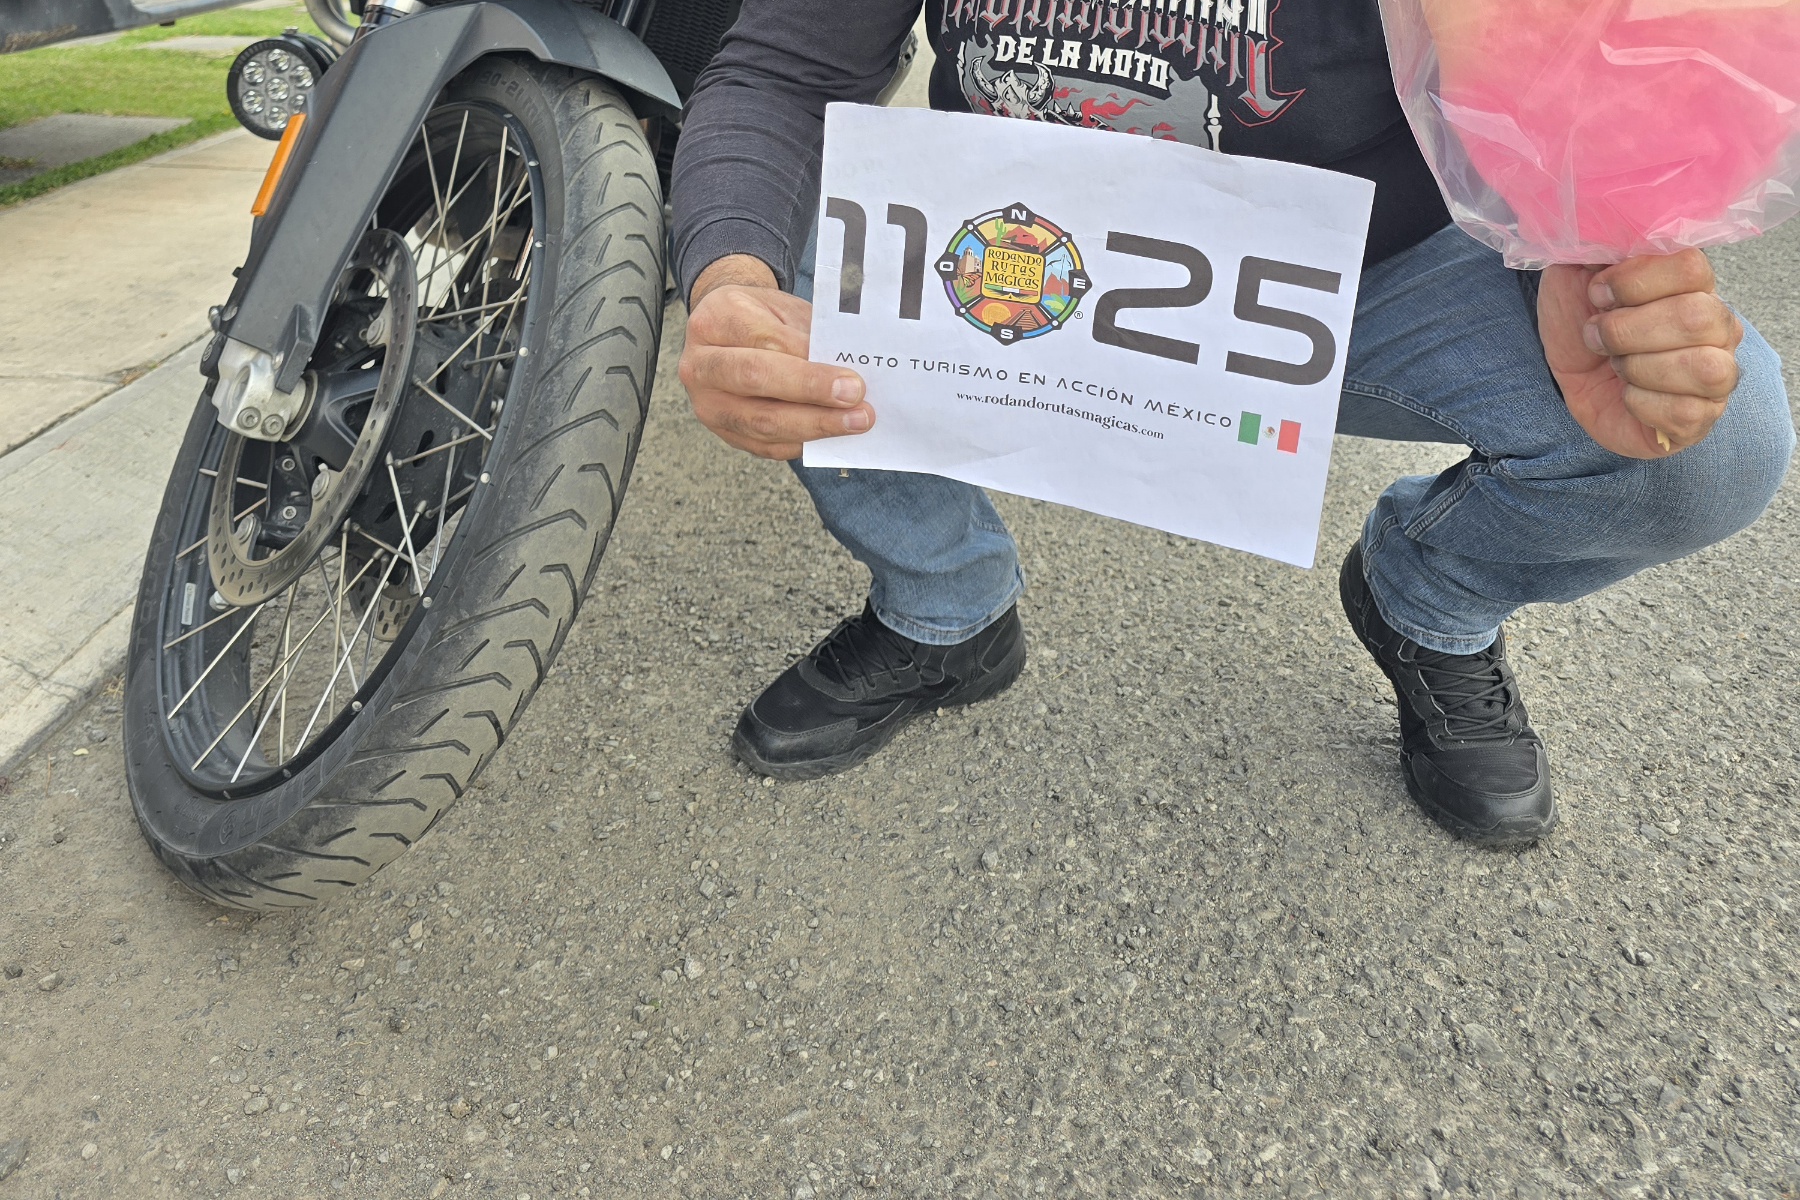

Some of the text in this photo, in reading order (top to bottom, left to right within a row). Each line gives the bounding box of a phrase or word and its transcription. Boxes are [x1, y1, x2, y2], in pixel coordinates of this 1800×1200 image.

[995, 35, 1171, 90] DE LA MOTO
[835, 352, 1232, 428] MOTO TURISMO EN ACCIÓN MÉXICO
[956, 392, 1164, 440] www.rodandorutasmagicas.com
